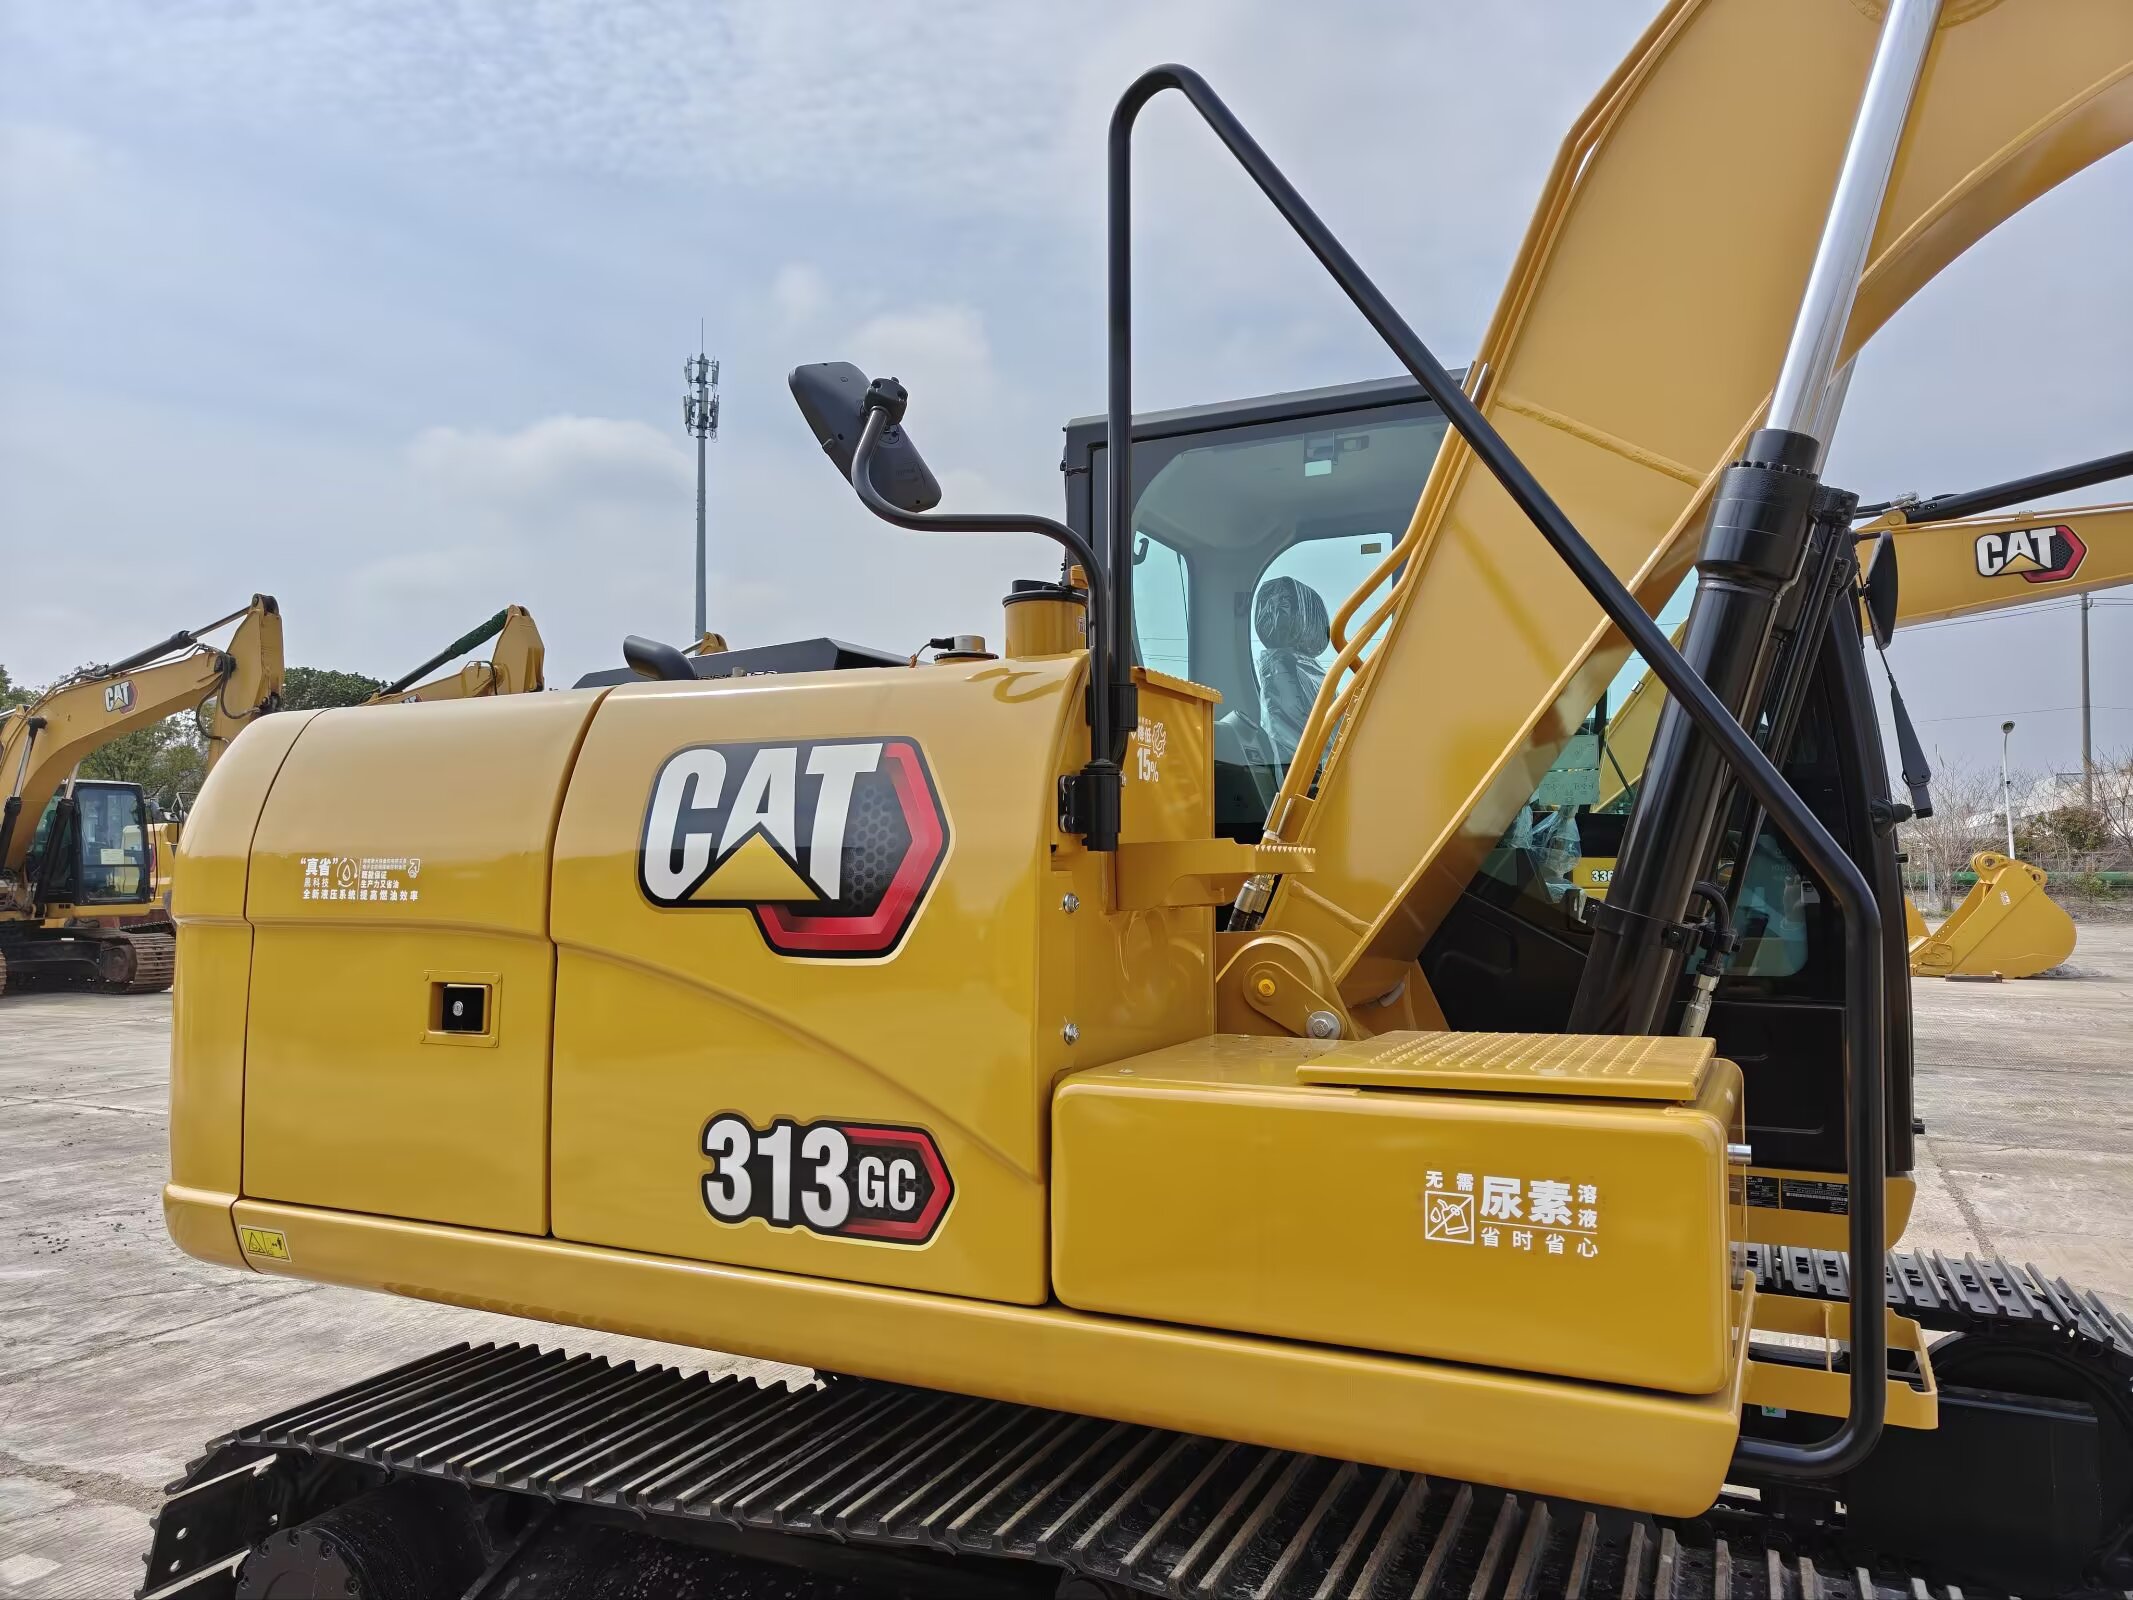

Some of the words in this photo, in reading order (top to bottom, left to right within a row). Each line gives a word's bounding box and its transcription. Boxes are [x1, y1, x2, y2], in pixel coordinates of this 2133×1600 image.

[1976, 527, 2057, 576] CAT
[105, 681, 129, 711] CAT
[1137, 747, 1159, 783] 15%
[644, 743, 883, 900] CAT
[706, 1119, 850, 1227] 313
[858, 1156, 916, 1211] GC
[1426, 1171, 1474, 1191] 无需
[1480, 1176, 1573, 1226] 尿素
[1480, 1227, 1598, 1257] 省时省心
